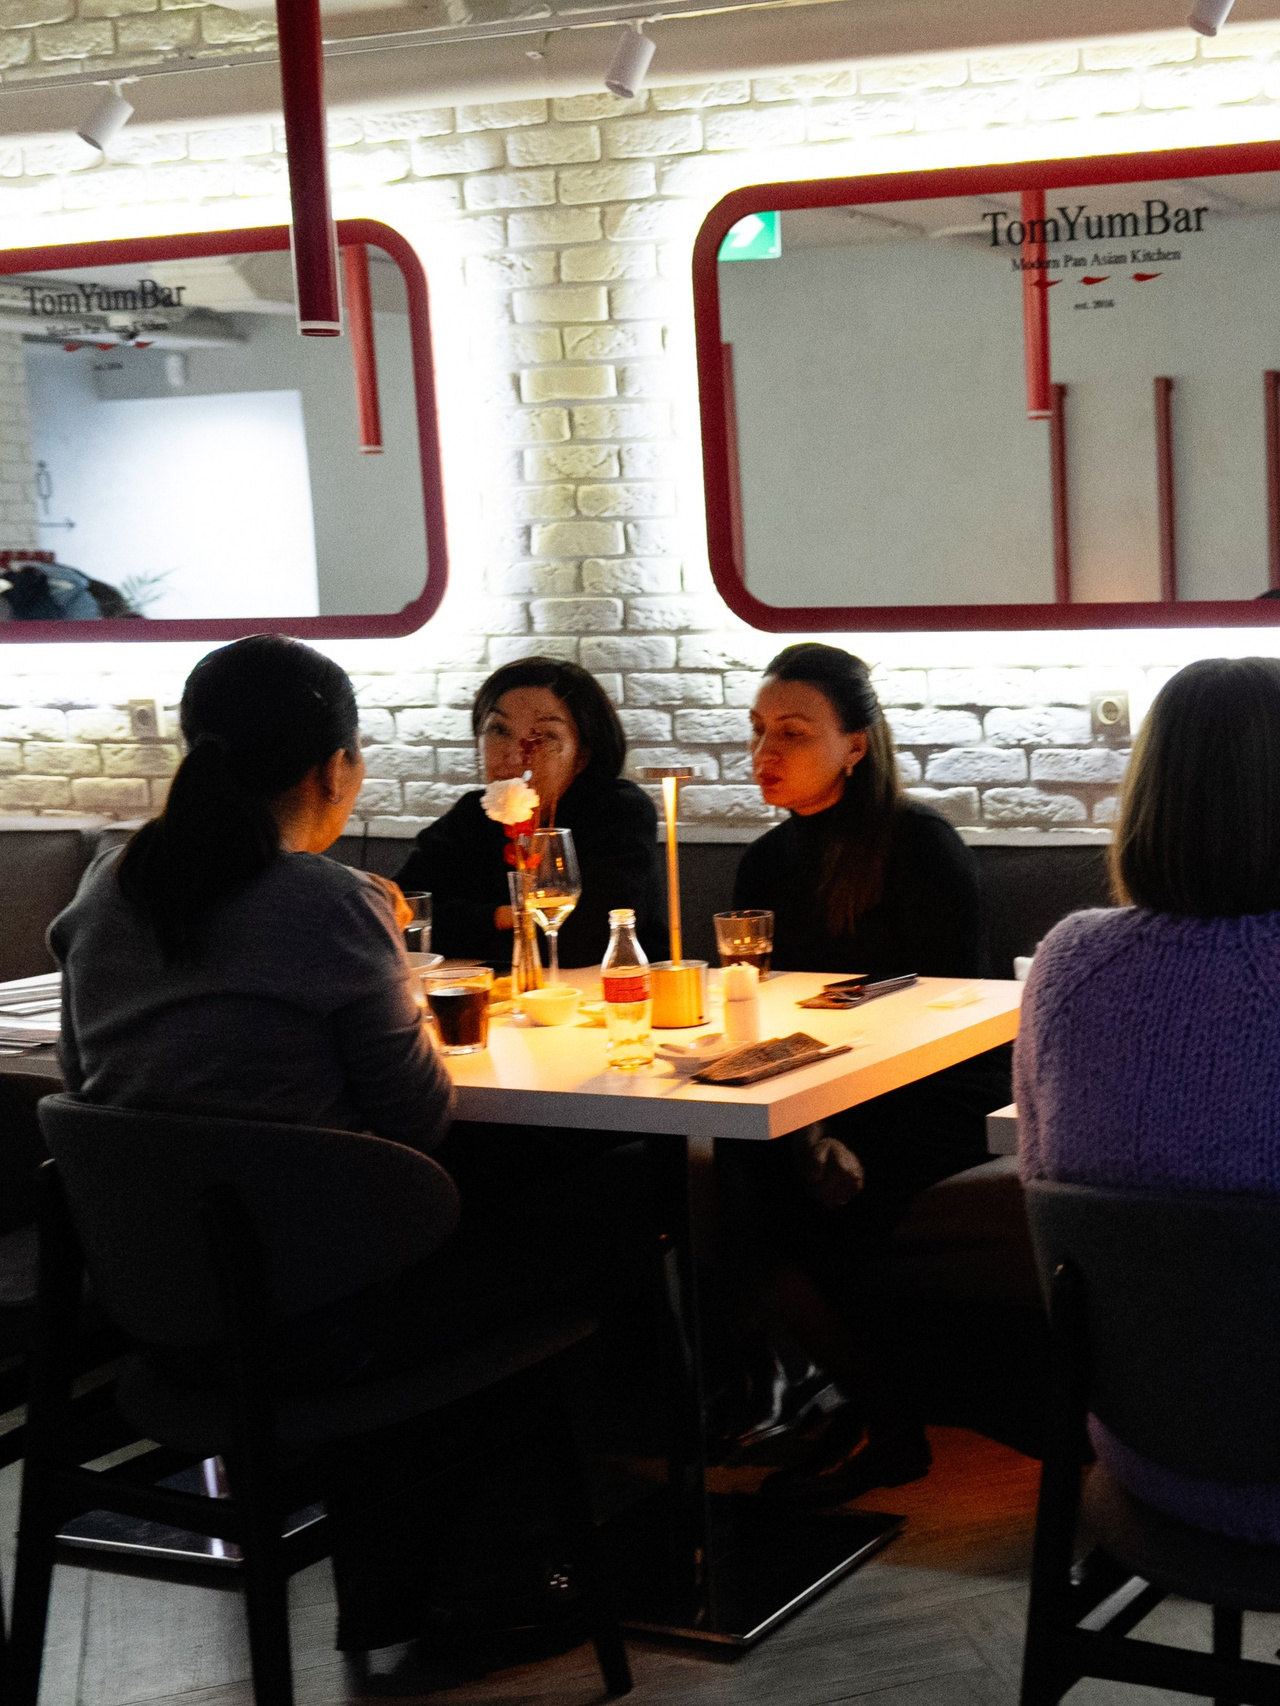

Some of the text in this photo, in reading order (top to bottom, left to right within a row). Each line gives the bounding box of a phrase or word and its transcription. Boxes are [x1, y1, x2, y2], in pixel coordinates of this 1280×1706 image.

[982, 199, 1209, 248] TomYumBar
[1063, 253, 1088, 268] Pan
[1091, 250, 1128, 266] Asian
[1130, 247, 1182, 264] Kitchen
[22, 279, 187, 316] TomYumBar
